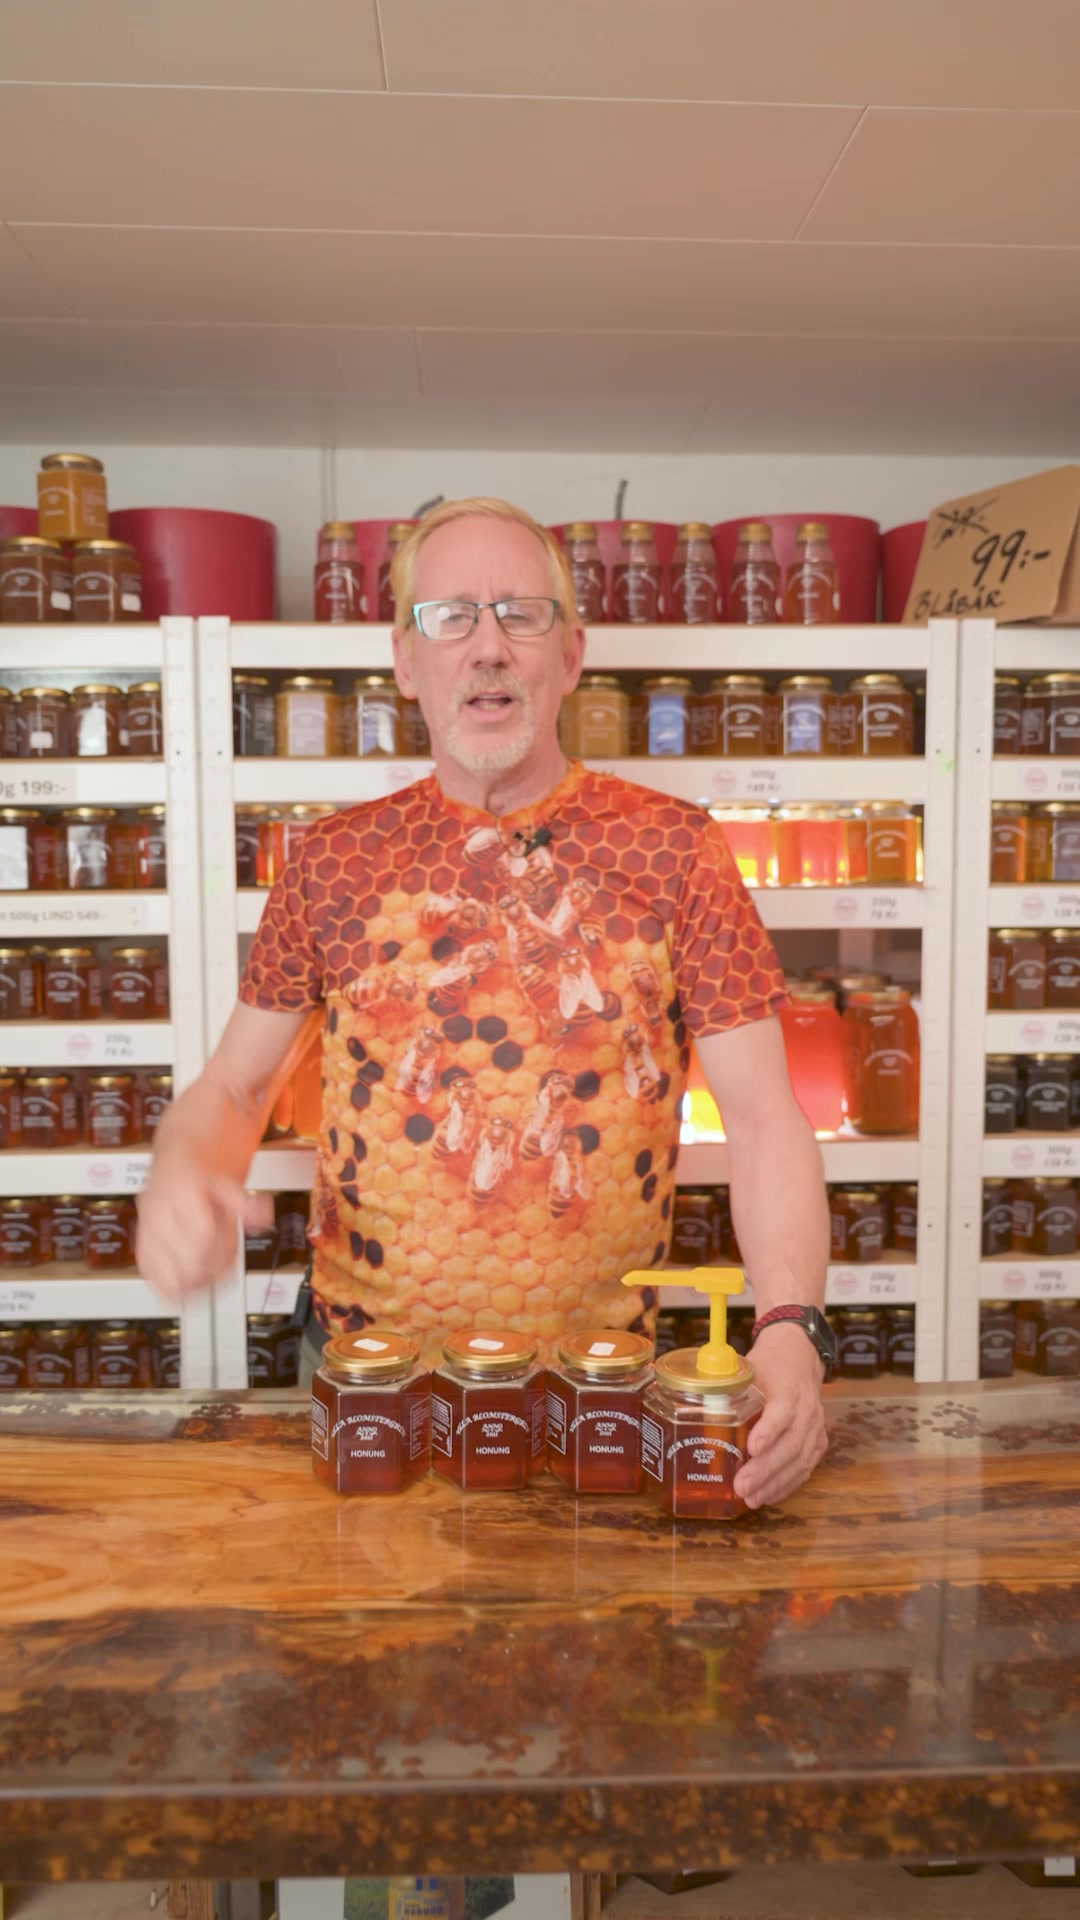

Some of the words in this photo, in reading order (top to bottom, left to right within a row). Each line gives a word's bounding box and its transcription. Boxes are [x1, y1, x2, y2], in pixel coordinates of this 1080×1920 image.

[971, 530, 1051, 588] 99:-
[21, 780, 67, 796] 199:-
[350, 1449, 386, 1458] HONUNG
[476, 1446, 511, 1455] HONUNG
[589, 1445, 625, 1454] HONUNG
[687, 1472, 724, 1482] HONUNG
